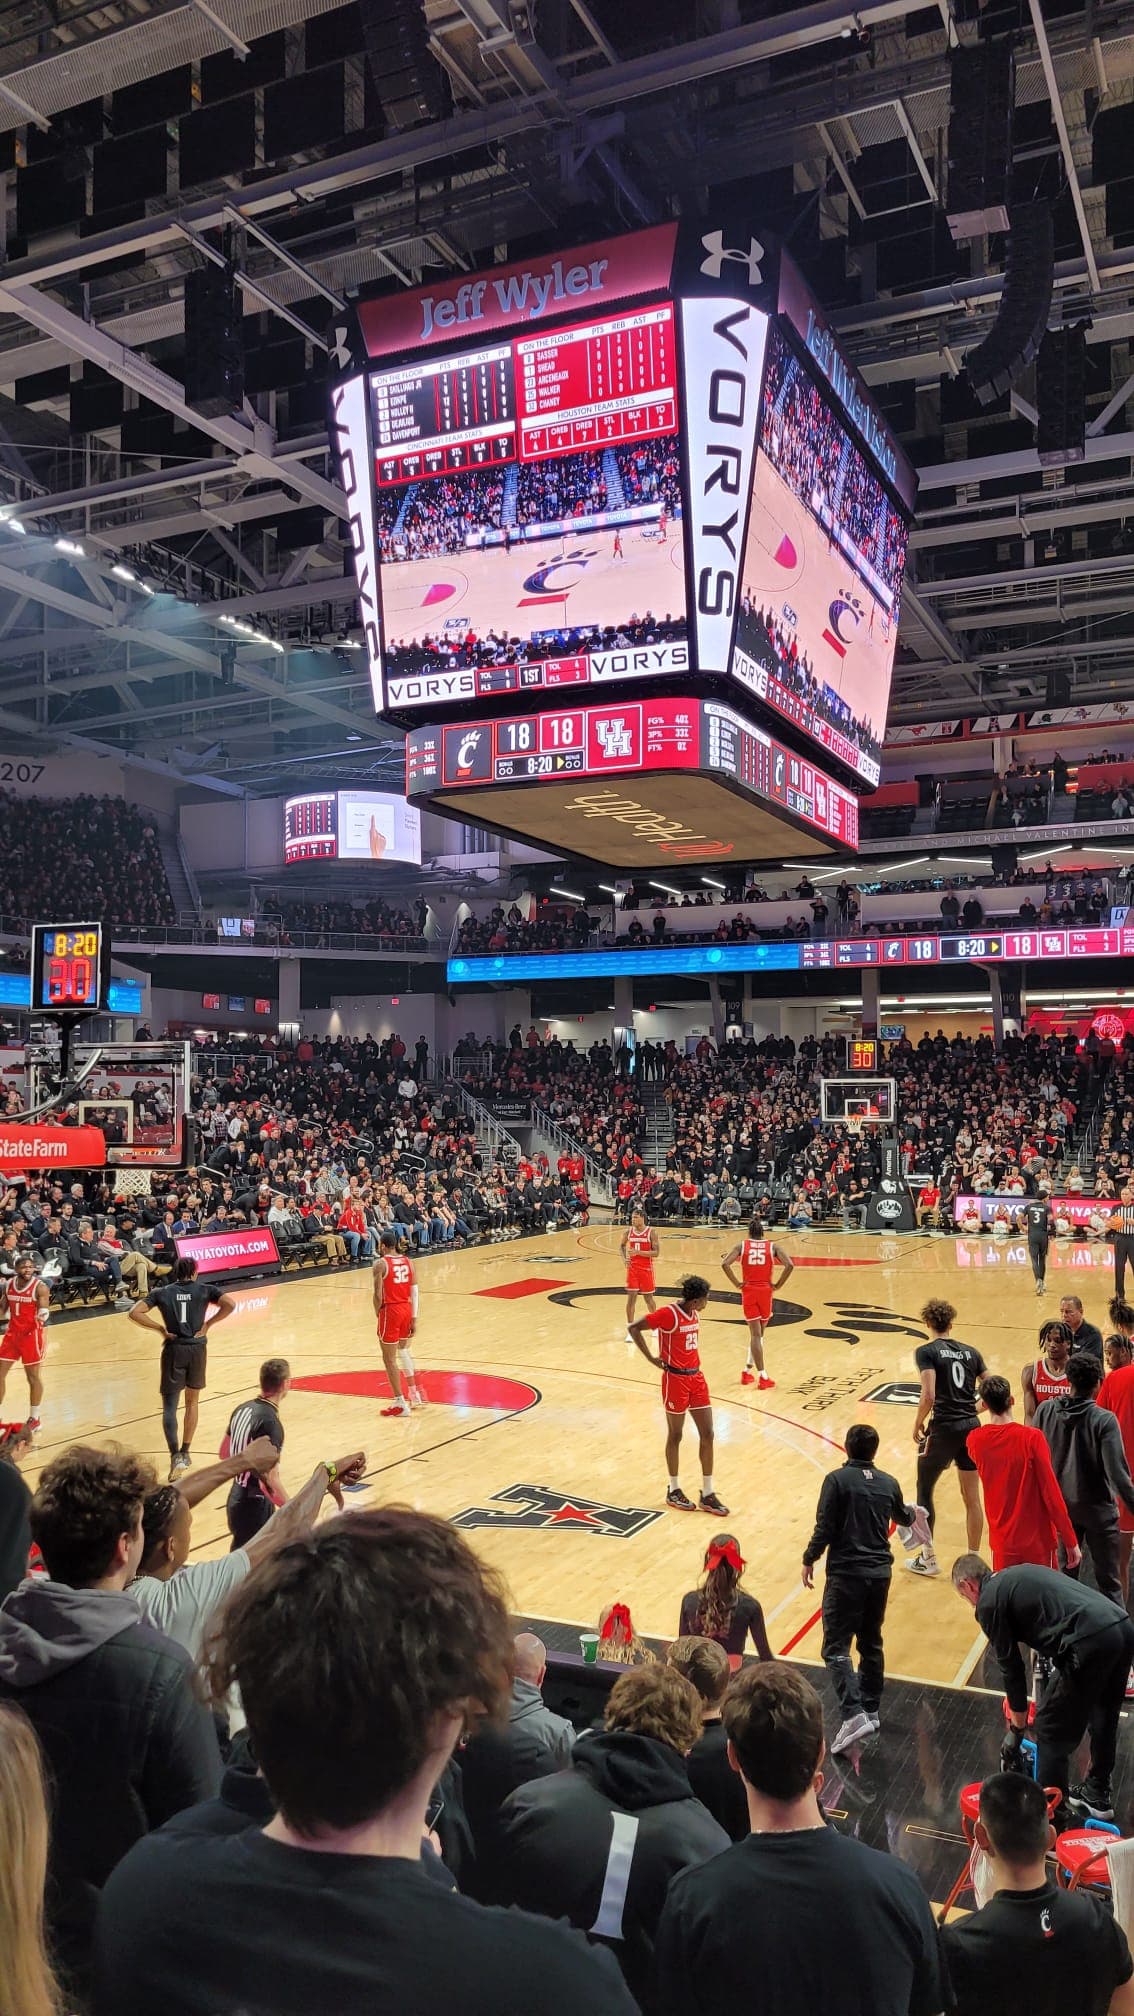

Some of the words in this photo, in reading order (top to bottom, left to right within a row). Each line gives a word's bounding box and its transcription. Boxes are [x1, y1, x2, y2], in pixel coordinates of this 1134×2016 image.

[420, 279, 488, 340] Jeff
[492, 258, 608, 318] Wyler
[523, 342, 535, 351] ON
[536, 338, 548, 349] THE
[550, 333, 574, 345] FLOOR
[591, 326, 604, 336] PTS
[611, 320, 626, 331] REB
[633, 315, 647, 326] AST
[656, 311, 666, 321] PF
[557, 407, 592, 421] HOUSTON
[593, 401, 614, 414] TEAM
[615, 396, 636, 409] STATS
[529, 429, 541, 440] AST
[575, 420, 593, 431] DREB
[603, 416, 615, 426] STL
[628, 410, 641, 421] BLK
[655, 405, 666, 414] TO
[699, 305, 750, 617] VORYS
[591, 646, 688, 675] VORYS
[523, 669, 539, 683] 1ST
[733, 651, 768, 693] VORYS
[389, 675, 474, 701] VORYS
[507, 723, 530, 750] 18
[551, 718, 574, 745] 18
[0, 763, 46, 784] 207
[528, 756, 552, 774] 8:20
[1026, 827, 1106, 840] VALENTINE
[54, 932, 97, 957] 8:20
[839, 944, 852, 952] TOL
[958, 939, 985, 957] 8:20
[1013, 936, 1031, 955] 18
[1073, 934, 1087, 942] TOL
[839, 955, 850, 963] FLS
[914, 941, 932, 960] 18
[1073, 945, 1086, 953] FLS
[48, 957, 91, 1002] 30
[855, 1043, 875, 1052] 8:20
[853, 1052, 872, 1068] 30
[1033, 1211, 1041, 1224] 3
[748, 1249, 766, 1265] 25
[393, 1264, 409, 1284] 32
[180, 1302, 188, 1323] 1
[685, 1333, 698, 1350] 23
[952, 1361, 965, 1389] 0
[802, 1388, 857, 1411] THIRD
